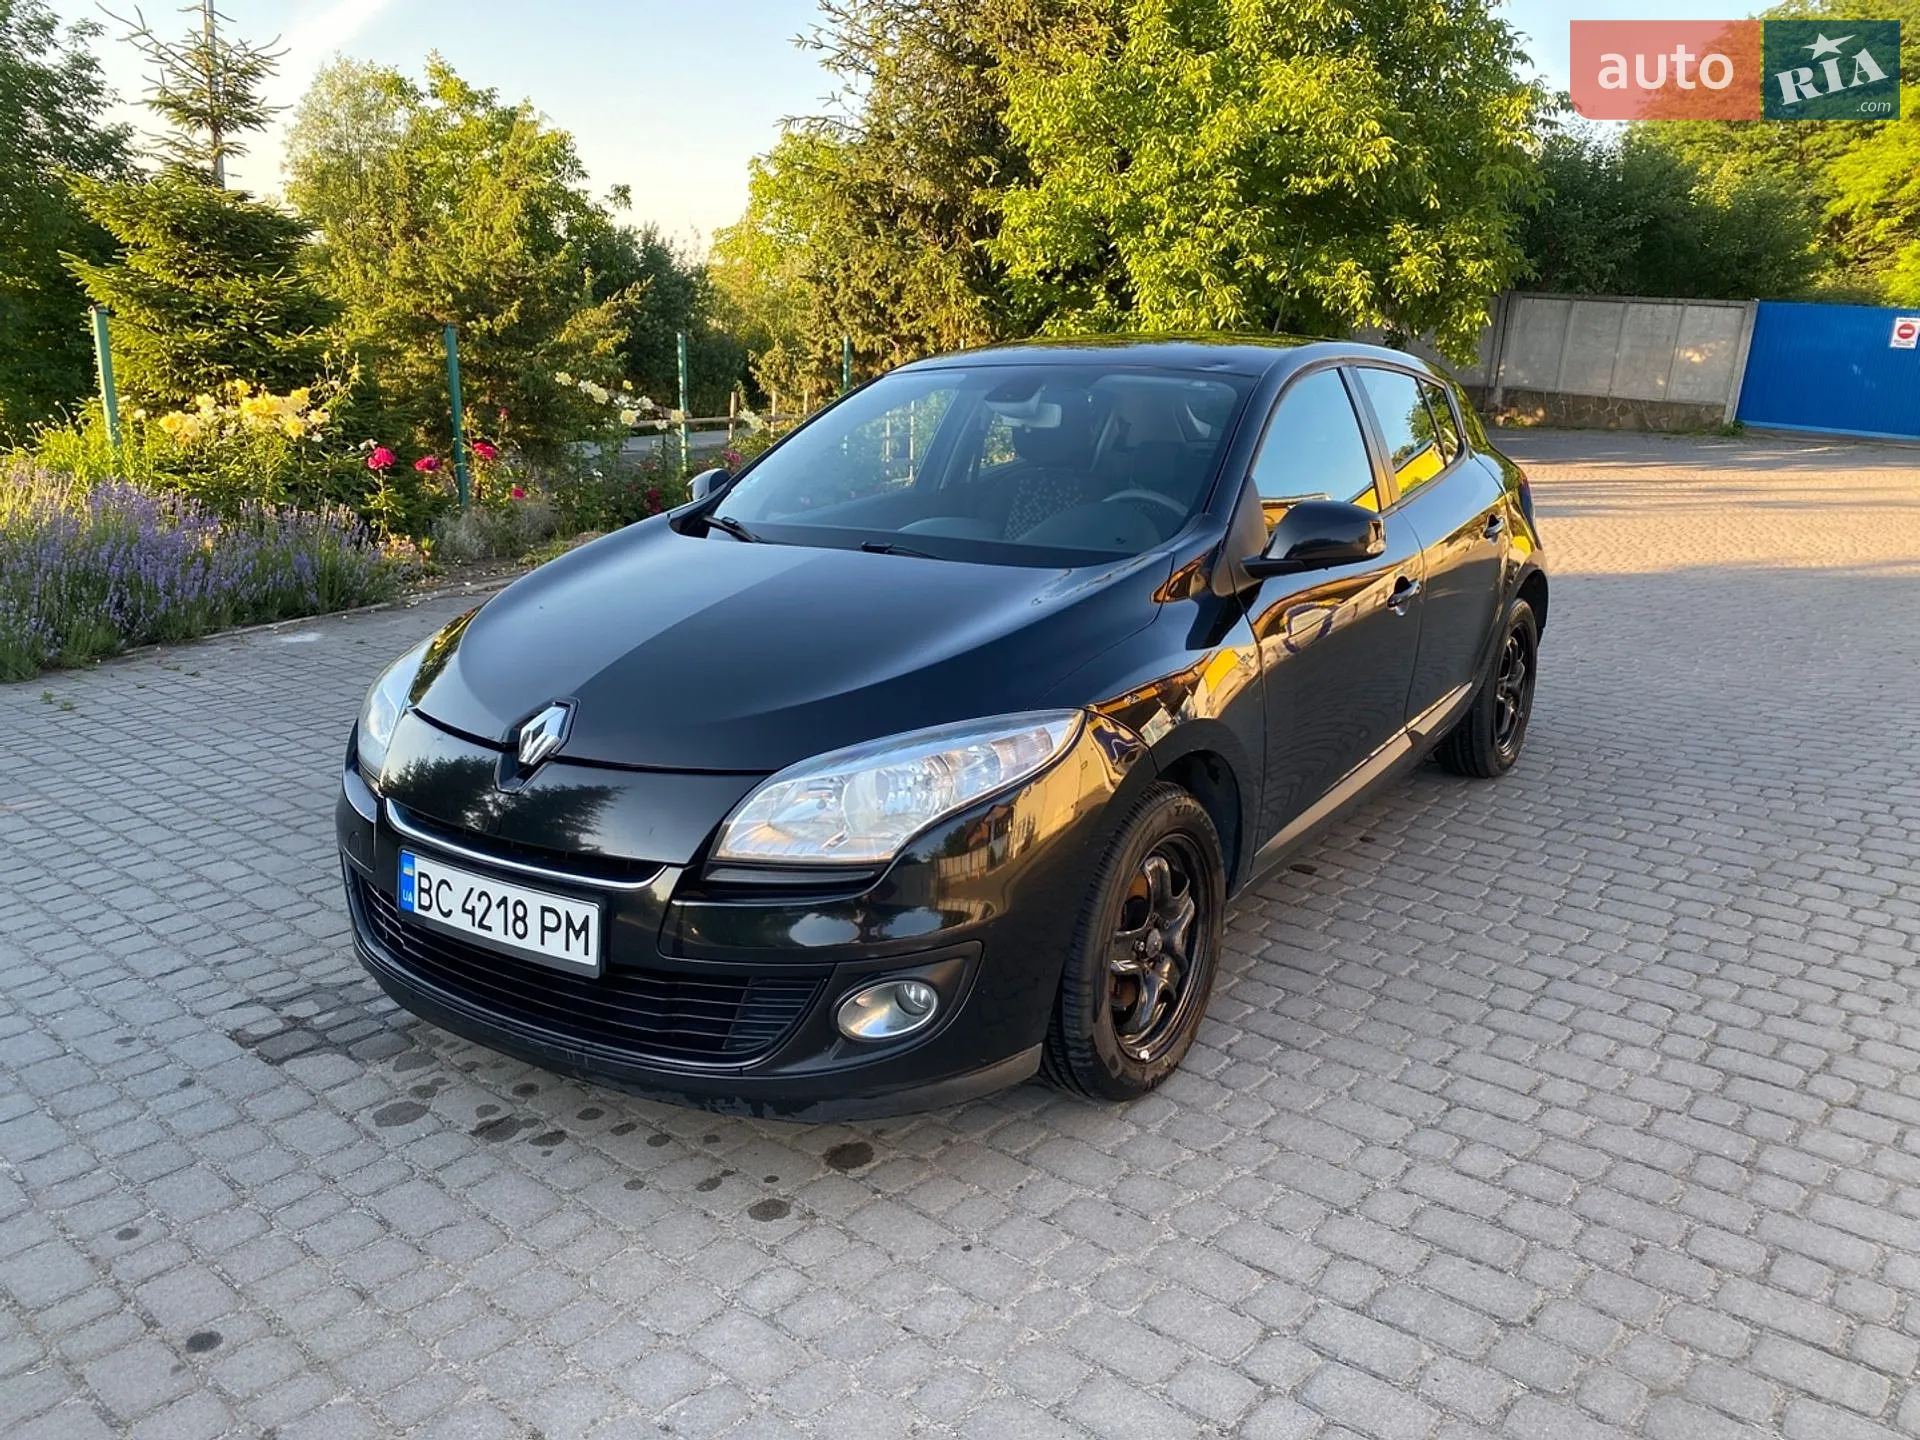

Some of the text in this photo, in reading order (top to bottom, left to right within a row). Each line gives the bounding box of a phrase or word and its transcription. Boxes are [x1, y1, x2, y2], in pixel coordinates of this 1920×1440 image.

[402, 889, 414, 904] UA
[417, 871, 590, 956] BC 4218 PM
